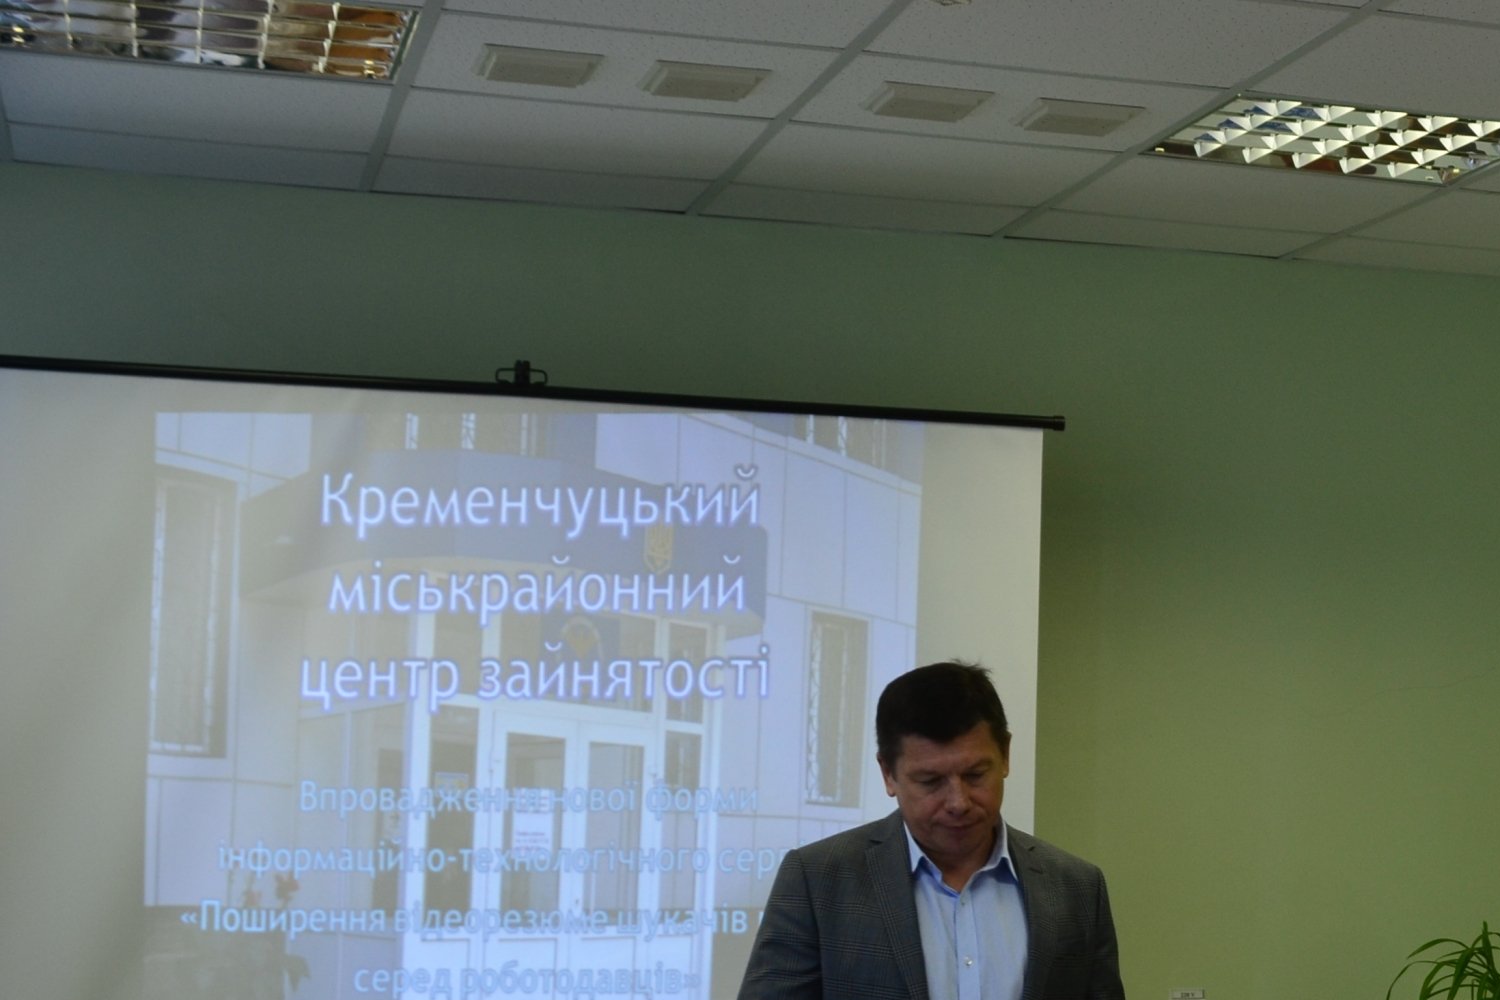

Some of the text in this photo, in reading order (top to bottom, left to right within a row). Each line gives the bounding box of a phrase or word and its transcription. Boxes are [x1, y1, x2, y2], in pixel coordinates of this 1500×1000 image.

[319, 465, 760, 539] Кременчуцький
[327, 554, 746, 624] міськрайонний
[301, 641, 770, 713] центр зайнятості
[299, 779, 758, 820] Впровадження нової форми
[218, 838, 709, 879] інформаційно-технологічного
[179, 897, 385, 942] «Поширення
[394, 899, 607, 942] відеорезюме
[615, 901, 748, 942] шукачів
[354, 965, 453, 1000] серед
